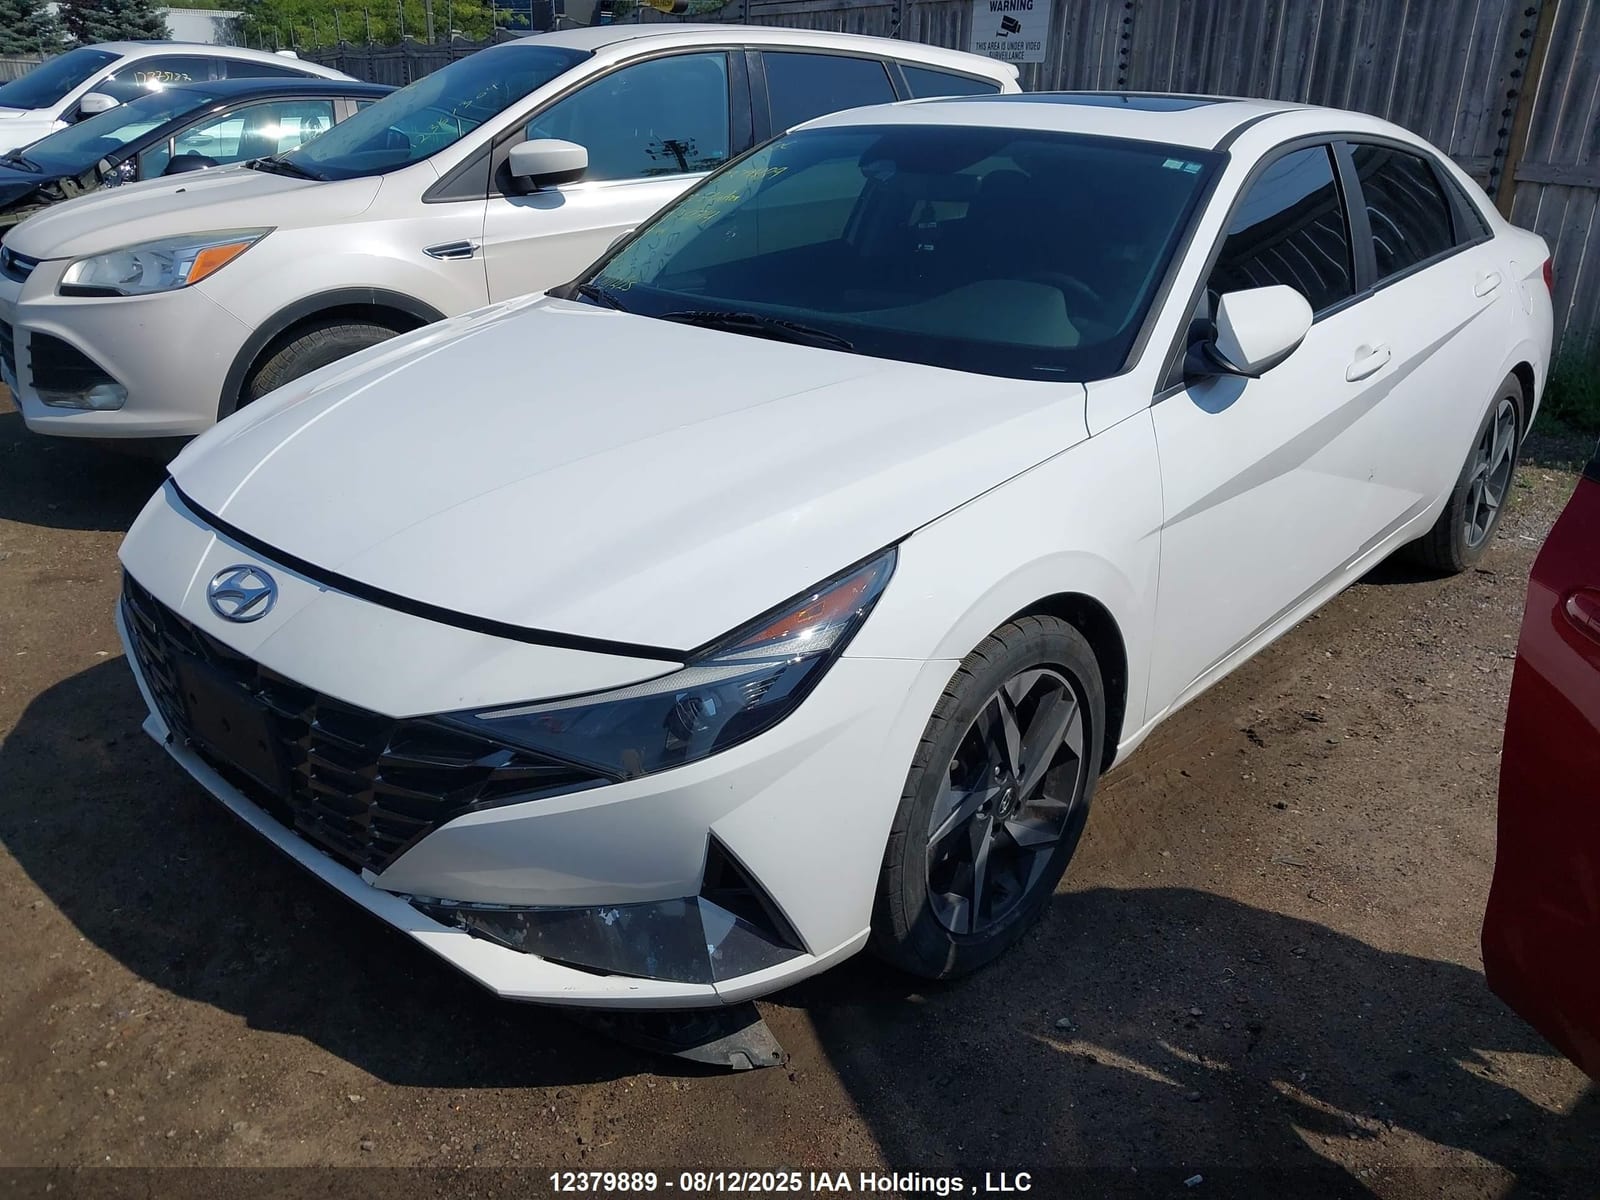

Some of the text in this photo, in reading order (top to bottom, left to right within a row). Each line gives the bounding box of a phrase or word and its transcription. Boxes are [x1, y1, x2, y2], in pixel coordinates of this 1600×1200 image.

[989, 0, 1033, 12] WARNING
[976, 41, 1041, 51] THIS AREA IS UNDER VIDEO
[989, 51, 1025, 60] SURVEILLANCE
